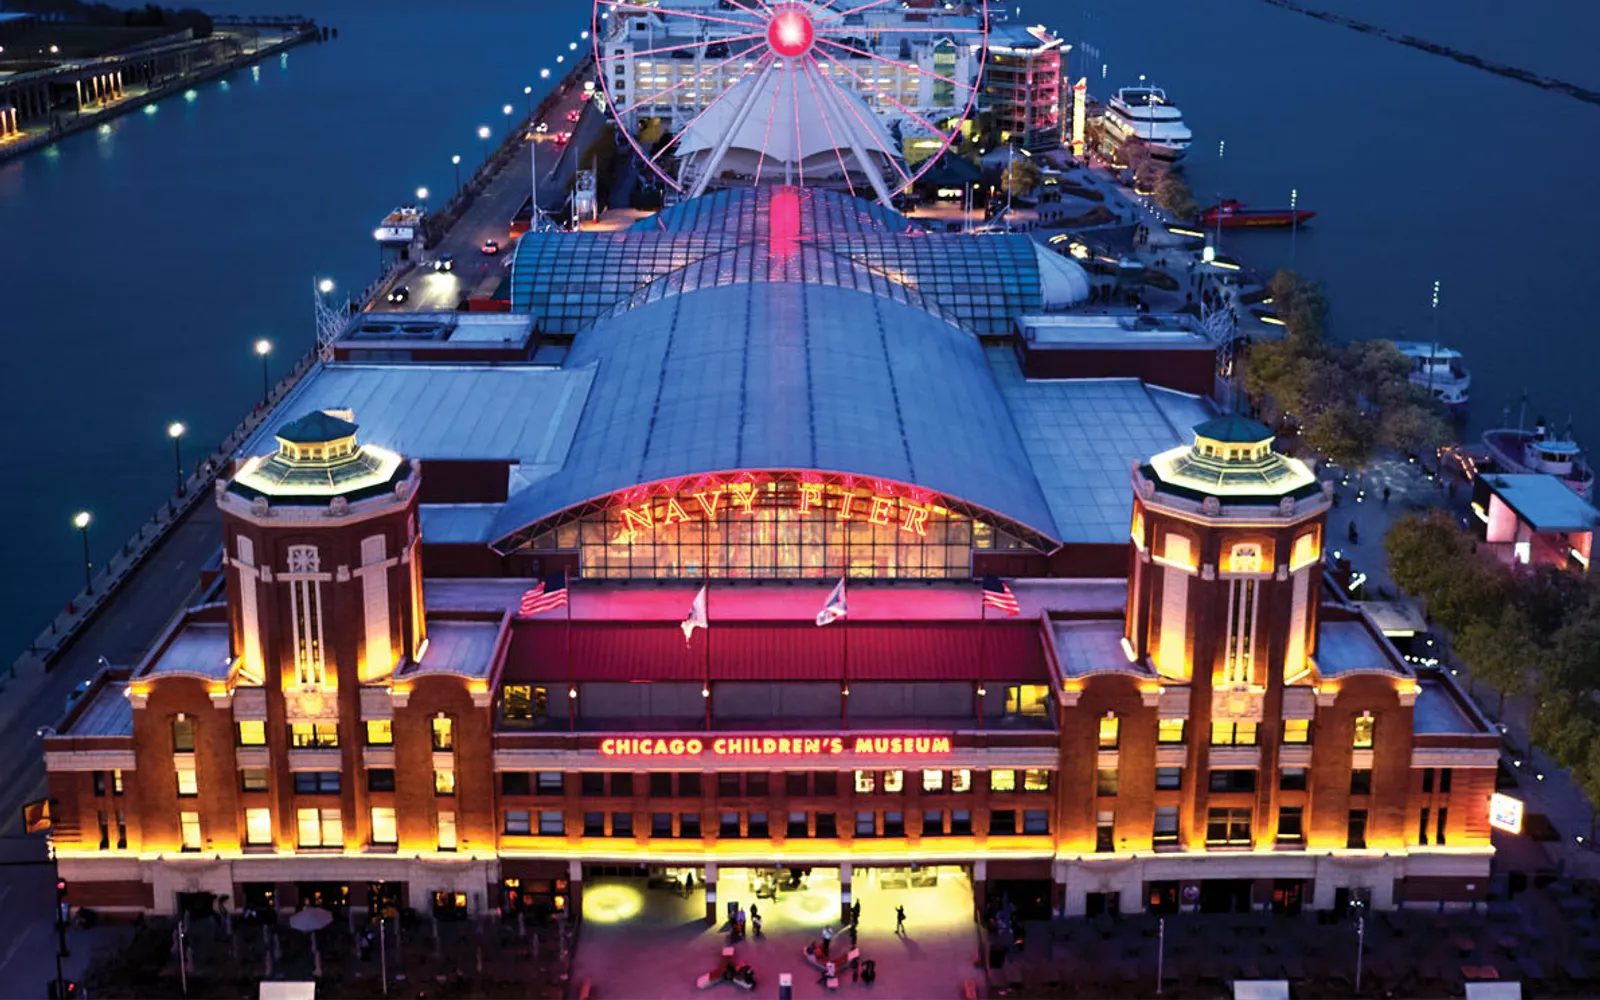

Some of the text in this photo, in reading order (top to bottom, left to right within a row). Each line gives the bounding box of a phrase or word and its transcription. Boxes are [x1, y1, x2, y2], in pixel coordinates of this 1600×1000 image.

[620, 487, 929, 536] NAVY PIER
[601, 736, 950, 756] CHICAGO CHILDREN'S MUSEUM
